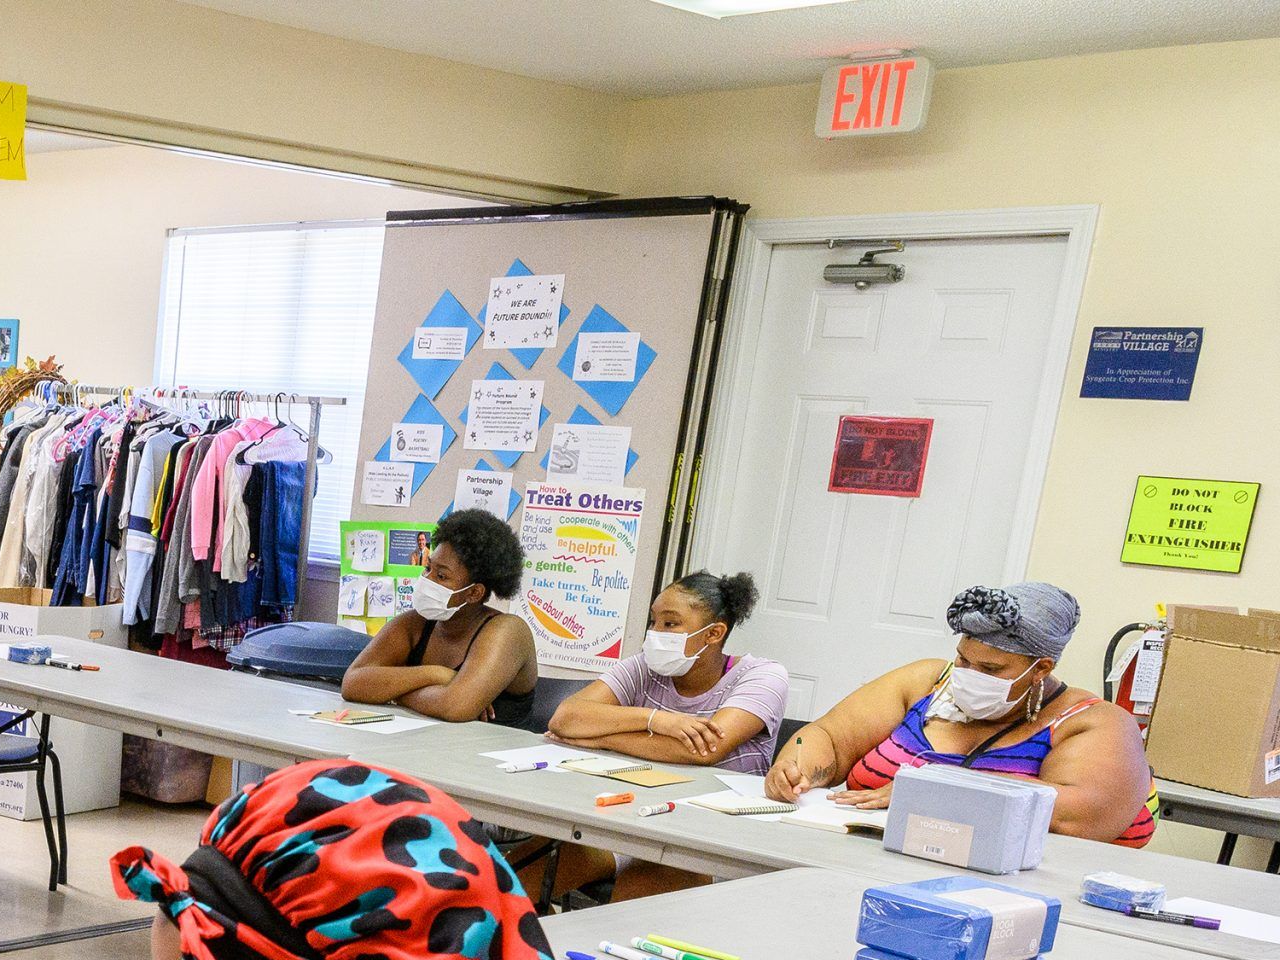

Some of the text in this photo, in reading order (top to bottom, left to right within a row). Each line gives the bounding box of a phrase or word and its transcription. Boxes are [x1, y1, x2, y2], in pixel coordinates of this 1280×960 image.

[831, 60, 916, 131] EXIT
[510, 299, 537, 308] WE ARE
[492, 313, 520, 321] FUTURE
[1123, 331, 1184, 343] Partnership
[1122, 342, 1170, 351] VILLAGE
[1116, 368, 1162, 376] Appreciation
[1085, 375, 1174, 384] Syngenta Crop Protection
[864, 426, 884, 435] NOT
[885, 427, 919, 437] BLOCK
[466, 475, 504, 485] Partnership
[472, 487, 494, 497] Village
[540, 485, 567, 494] How to
[1171, 487, 1220, 499] DO NOT
[527, 490, 643, 512] Treat Others
[1169, 502, 1213, 513] BLOCK
[524, 511, 552, 525] Be kind
[1168, 518, 1208, 531] FIRE
[523, 524, 553, 534] and use
[559, 515, 601, 528] Cooperate
[602, 521, 618, 535] with
[557, 538, 619, 557] Be helpful.
[1127, 533, 1242, 552] EXTINGUISHER
[1163, 551, 1182, 559] Thank
[535, 560, 577, 574] gentle.
[532, 577, 589, 593] Take turns.
[591, 568, 630, 592] Be polite.
[565, 592, 603, 605] Be fair.
[526, 589, 586, 640] Care about others,
[586, 605, 620, 619] Share.
[521, 602, 529, 616] the
[527, 615, 550, 642] thoughts
[550, 638, 563, 649] and
[564, 642, 591, 652] feelings
[591, 637, 600, 647] of
[536, 648, 552, 659] Give
[5, 779, 25, 790] 27406
[920, 821, 960, 834] YOGA BLOCK
[994, 918, 1015, 932] YOGA
[992, 927, 1015, 941] BLOCK
